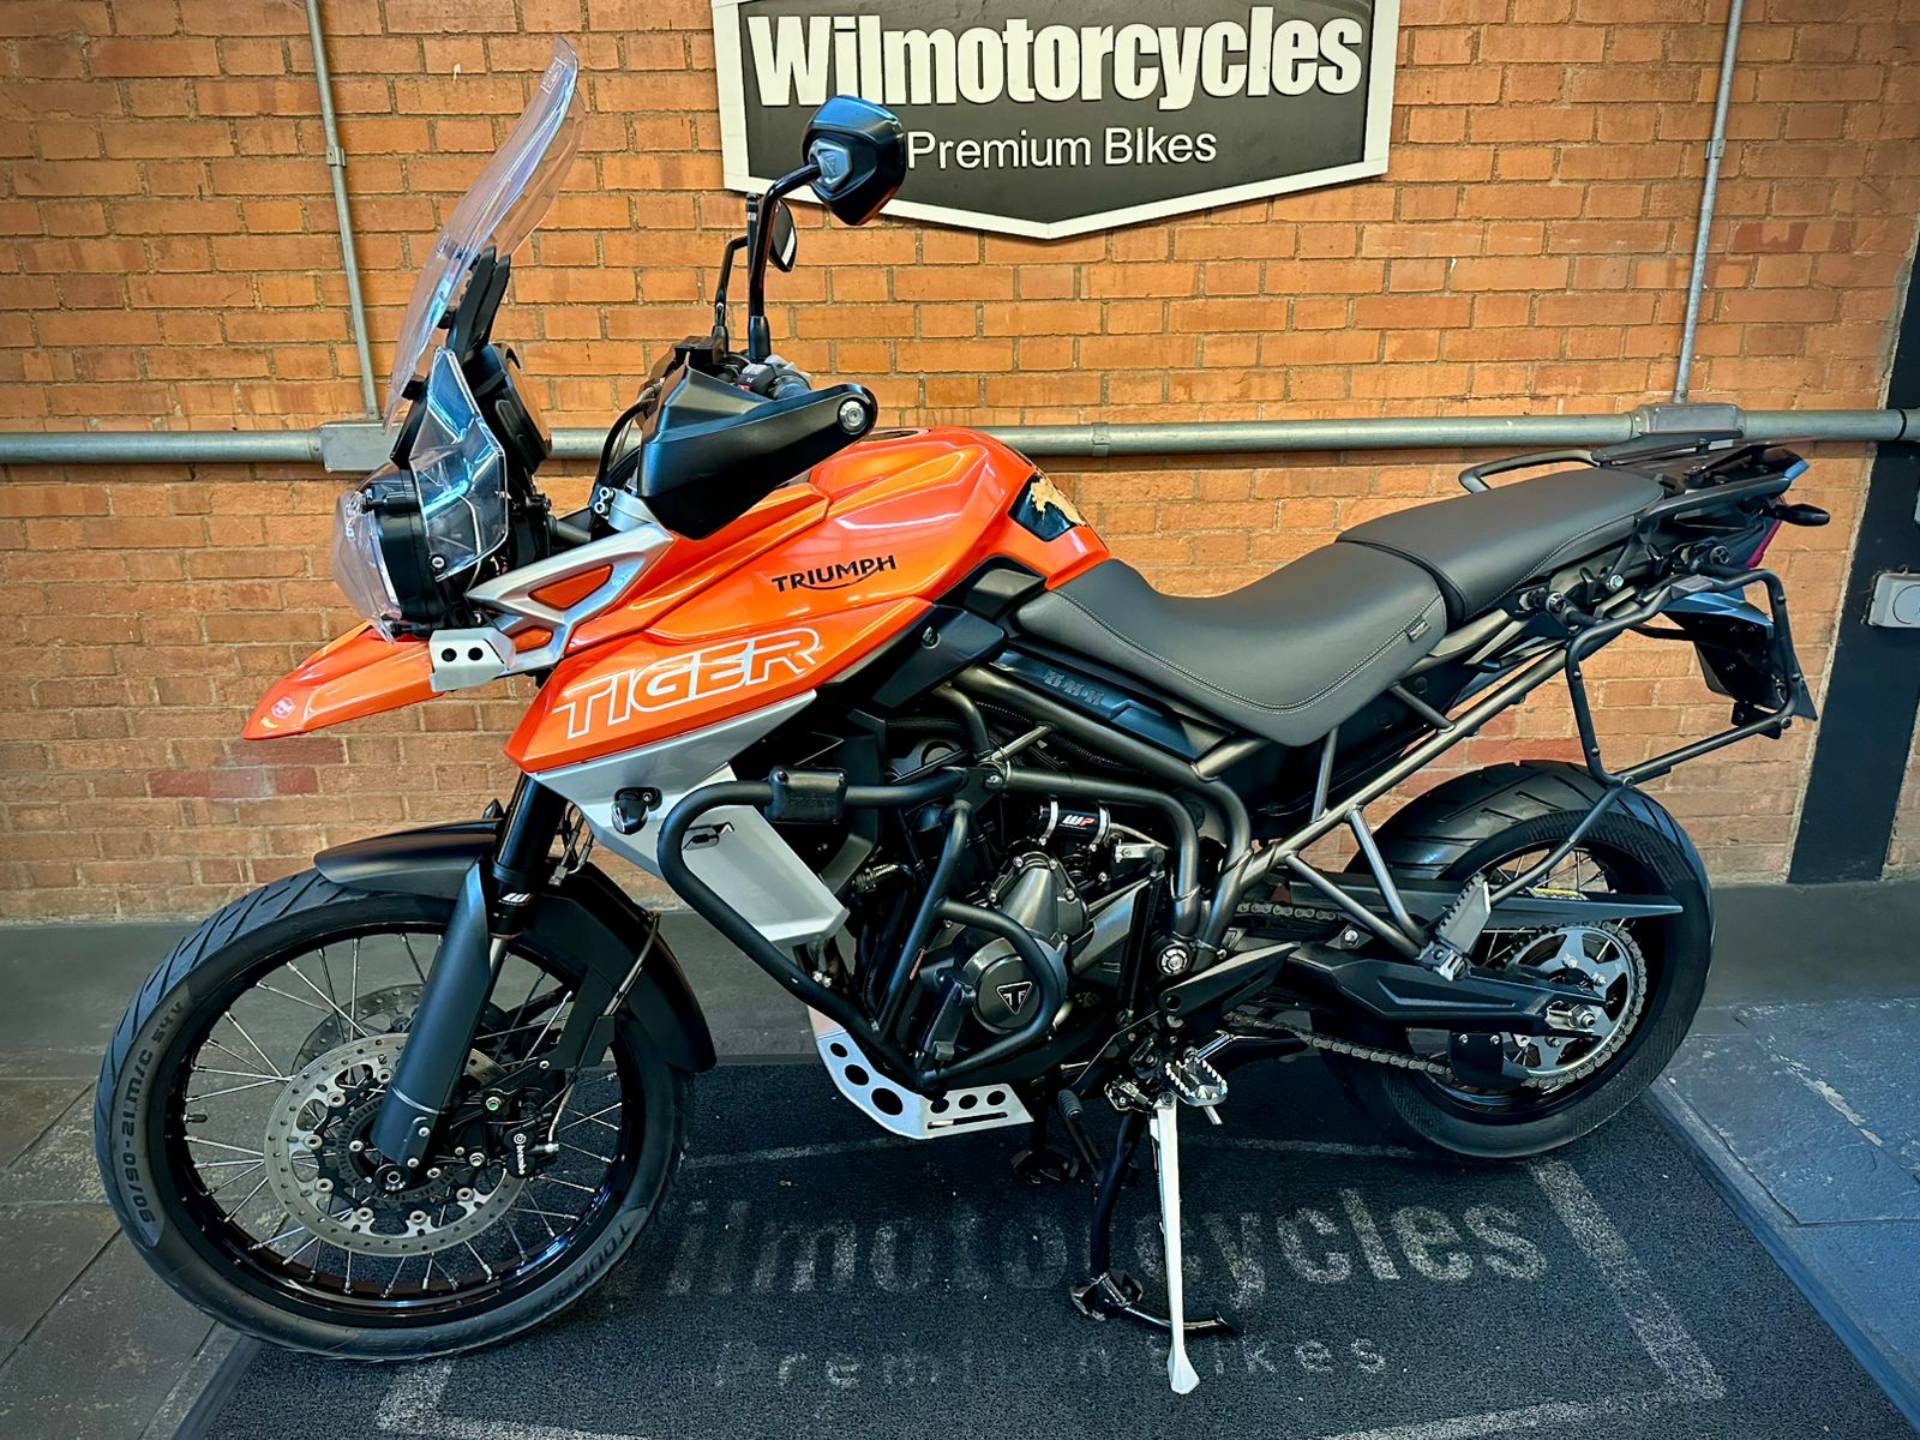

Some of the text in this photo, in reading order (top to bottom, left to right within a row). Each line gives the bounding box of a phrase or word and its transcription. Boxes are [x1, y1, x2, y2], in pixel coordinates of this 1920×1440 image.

[747, 7, 1364, 110] Wilmotorcycles
[906, 129, 1091, 169] Premium
[771, 554, 896, 592] TRIUMPH
[551, 626, 825, 740] TIGER
